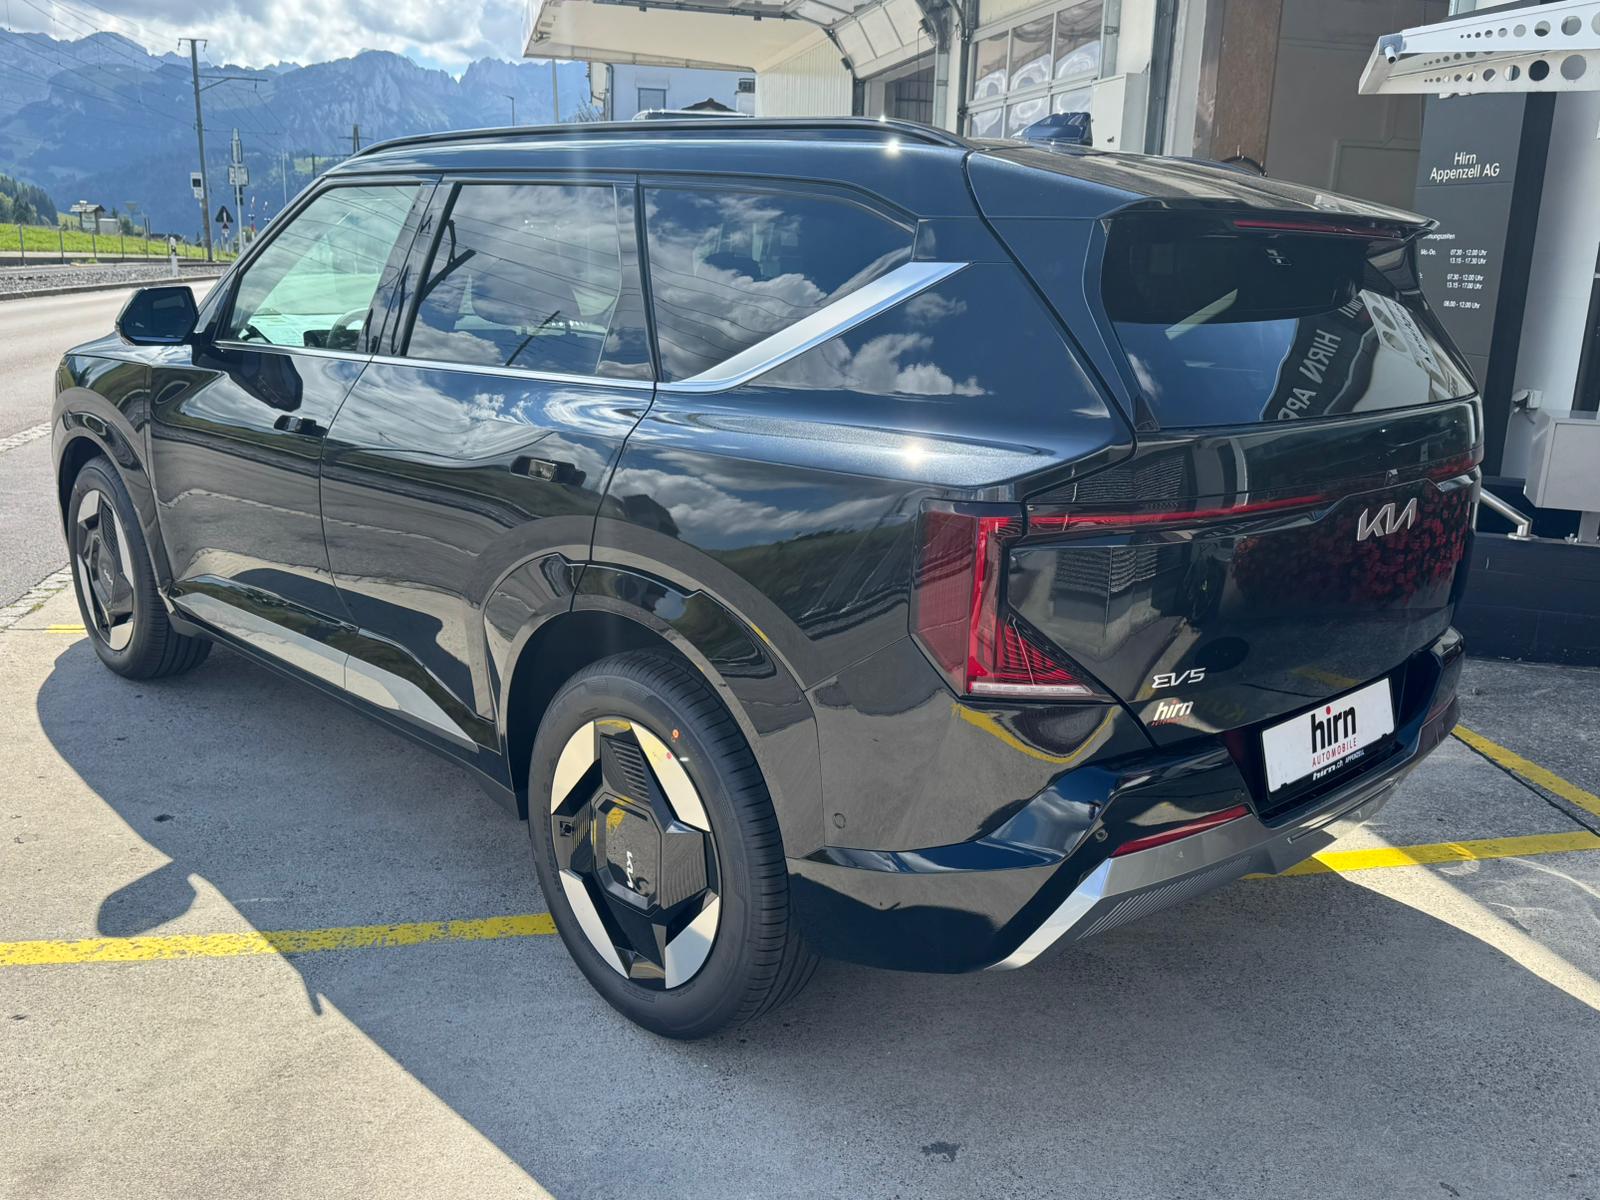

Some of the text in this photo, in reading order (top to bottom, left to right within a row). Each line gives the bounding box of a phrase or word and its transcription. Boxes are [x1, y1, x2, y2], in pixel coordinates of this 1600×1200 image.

[1454, 152, 1477, 165] Hirn
[1430, 162, 1500, 183] Appenzell AG
[1357, 497, 1418, 542] KIA
[1151, 667, 1206, 689] EV5
[1153, 699, 1194, 721] hirn
[1311, 705, 1357, 754] hirn
[1312, 737, 1357, 767] AUTOMOBILE
[1312, 760, 1344, 781] hirn.ch
